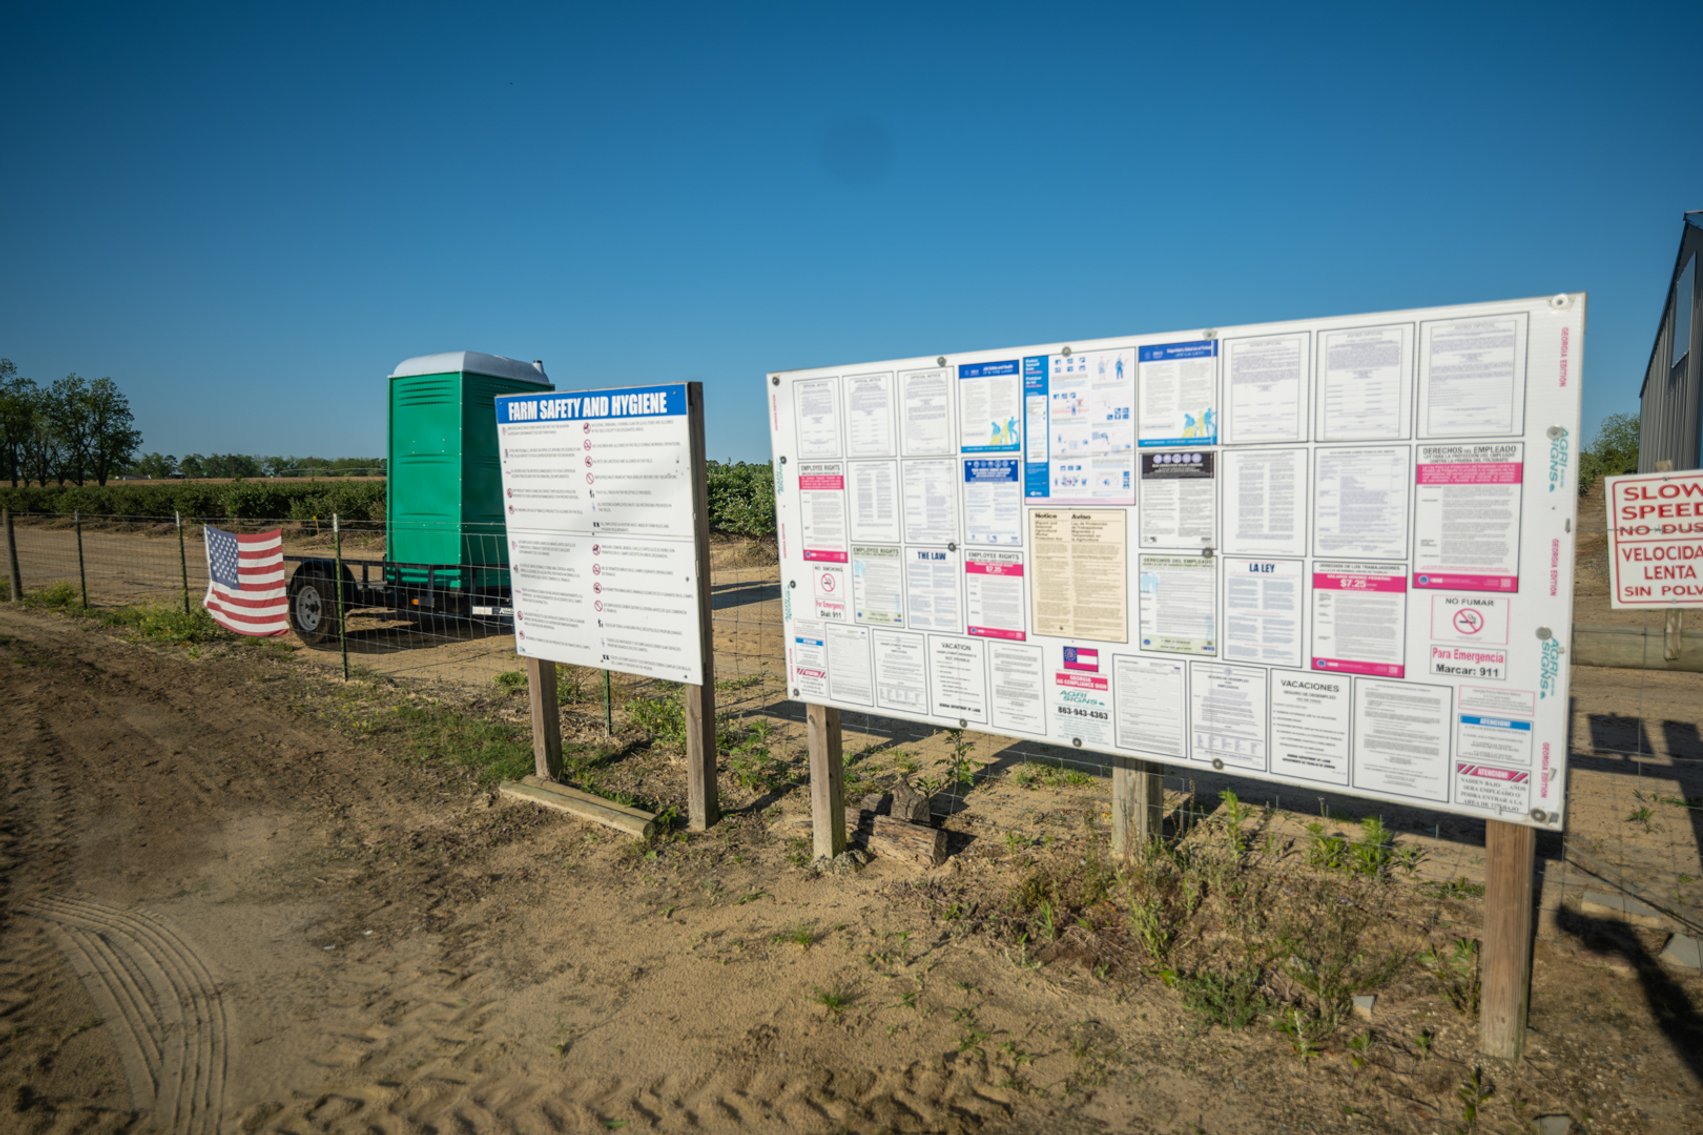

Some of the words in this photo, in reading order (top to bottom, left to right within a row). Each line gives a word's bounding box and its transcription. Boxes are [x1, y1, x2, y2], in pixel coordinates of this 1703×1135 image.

[1560, 327, 1569, 357] GEORGIA
[1559, 360, 1567, 388] EDITION
[508, 401, 538, 420] FARM
[540, 398, 582, 420] SAFETY
[582, 396, 609, 418] AND
[612, 392, 668, 416] HYGIENE
[1624, 483, 1703, 501] SLOW
[1620, 525, 1650, 536] NO
[1662, 523, 1703, 534] DUS
[918, 552, 929, 560] THE
[931, 552, 946, 560] LAW
[1622, 546, 1703, 561] VELOCIDA
[1249, 563, 1259, 572] LA
[1261, 564, 1275, 573] LEY
[1644, 565, 1696, 580] LENTA
[1340, 579, 1366, 588] $7.25
[1625, 586, 1651, 597] SIN
[1662, 585, 1703, 596] POLV
[941, 642, 971, 651] VACATION
[1432, 647, 1451, 659] Para
[1454, 649, 1504, 664] Emergencia
[1550, 636, 1559, 676] AGRI
[1436, 664, 1476, 676] Marcar:
[1480, 667, 1499, 677] 911
[1540, 641, 1550, 690] SIGNS
[1281, 680, 1339, 692] VACACIONES
[1064, 696, 1098, 705] SIGNS
